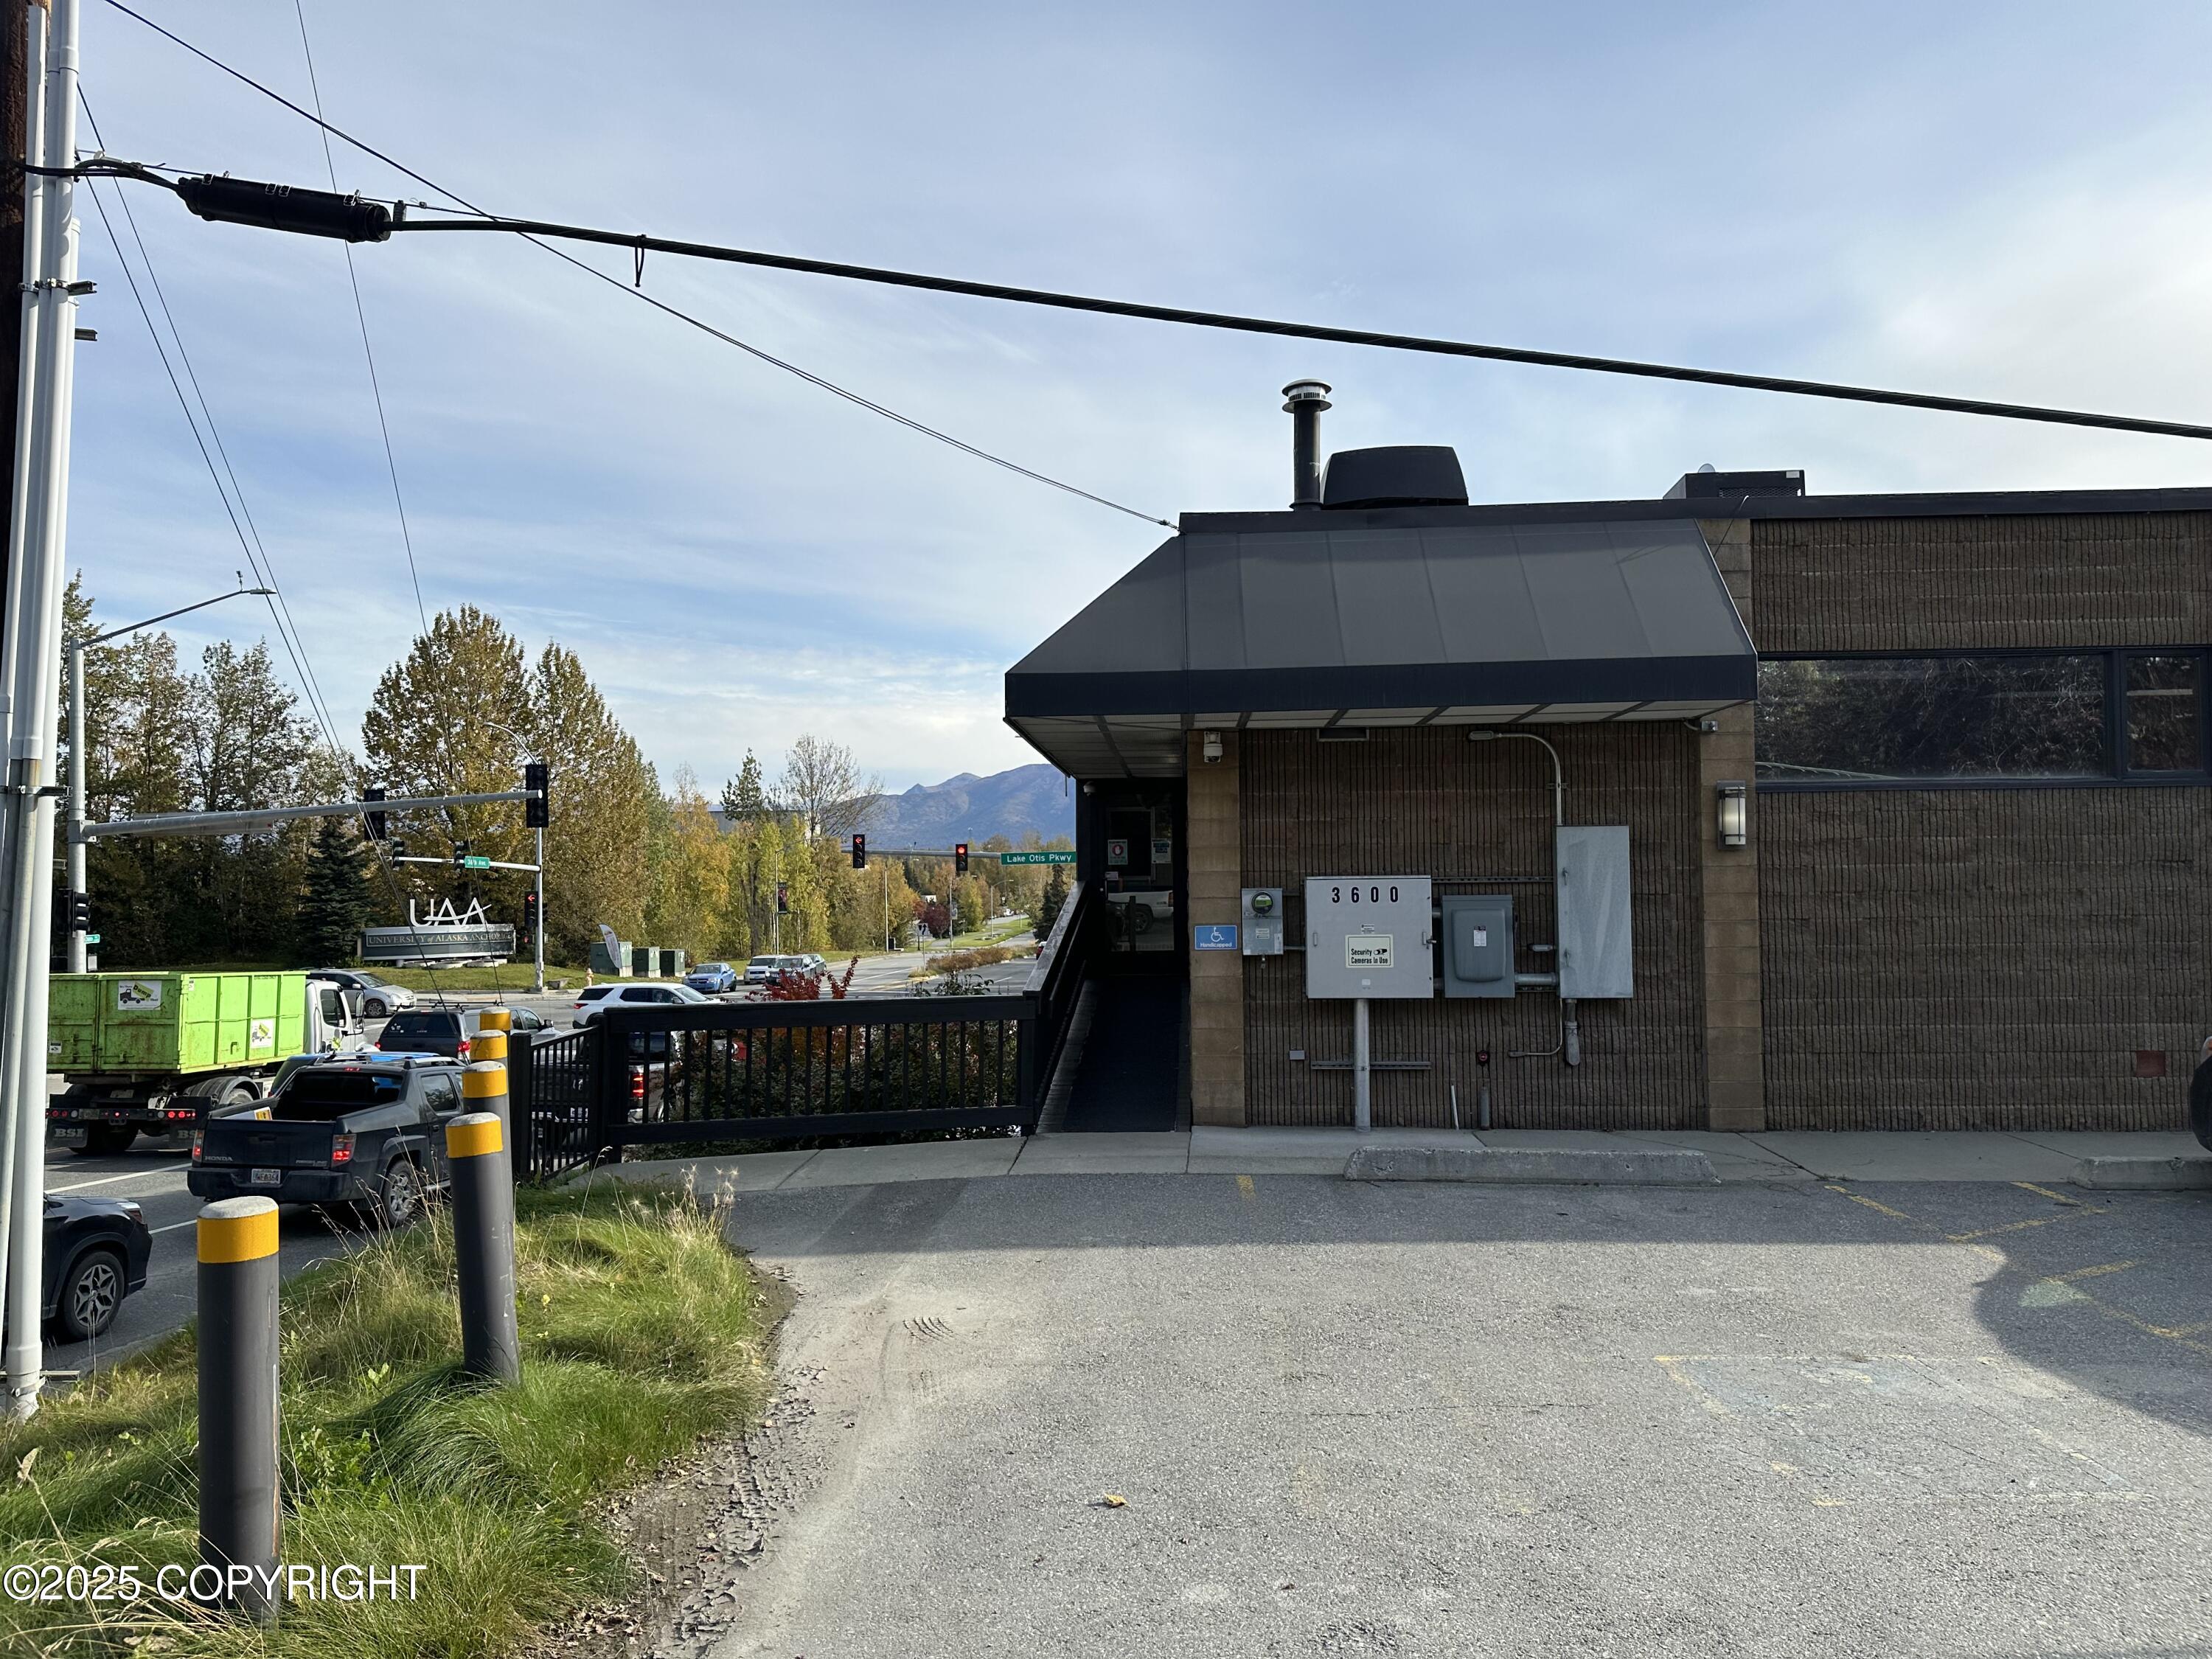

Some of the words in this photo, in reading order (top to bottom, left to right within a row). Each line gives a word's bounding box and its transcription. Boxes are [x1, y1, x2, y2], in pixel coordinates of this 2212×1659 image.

[1049, 854, 1071, 862] Pkwy
[1332, 886, 1399, 903] 3600
[409, 897, 492, 927] UAA
[427, 935, 434, 943] of
[436, 933, 468, 942] ALASKA
[1351, 948, 1372, 956] Security
[133, 984, 152, 998] Dump
[54, 1128, 84, 1137] BSI
[177, 1130, 196, 1139] BS
